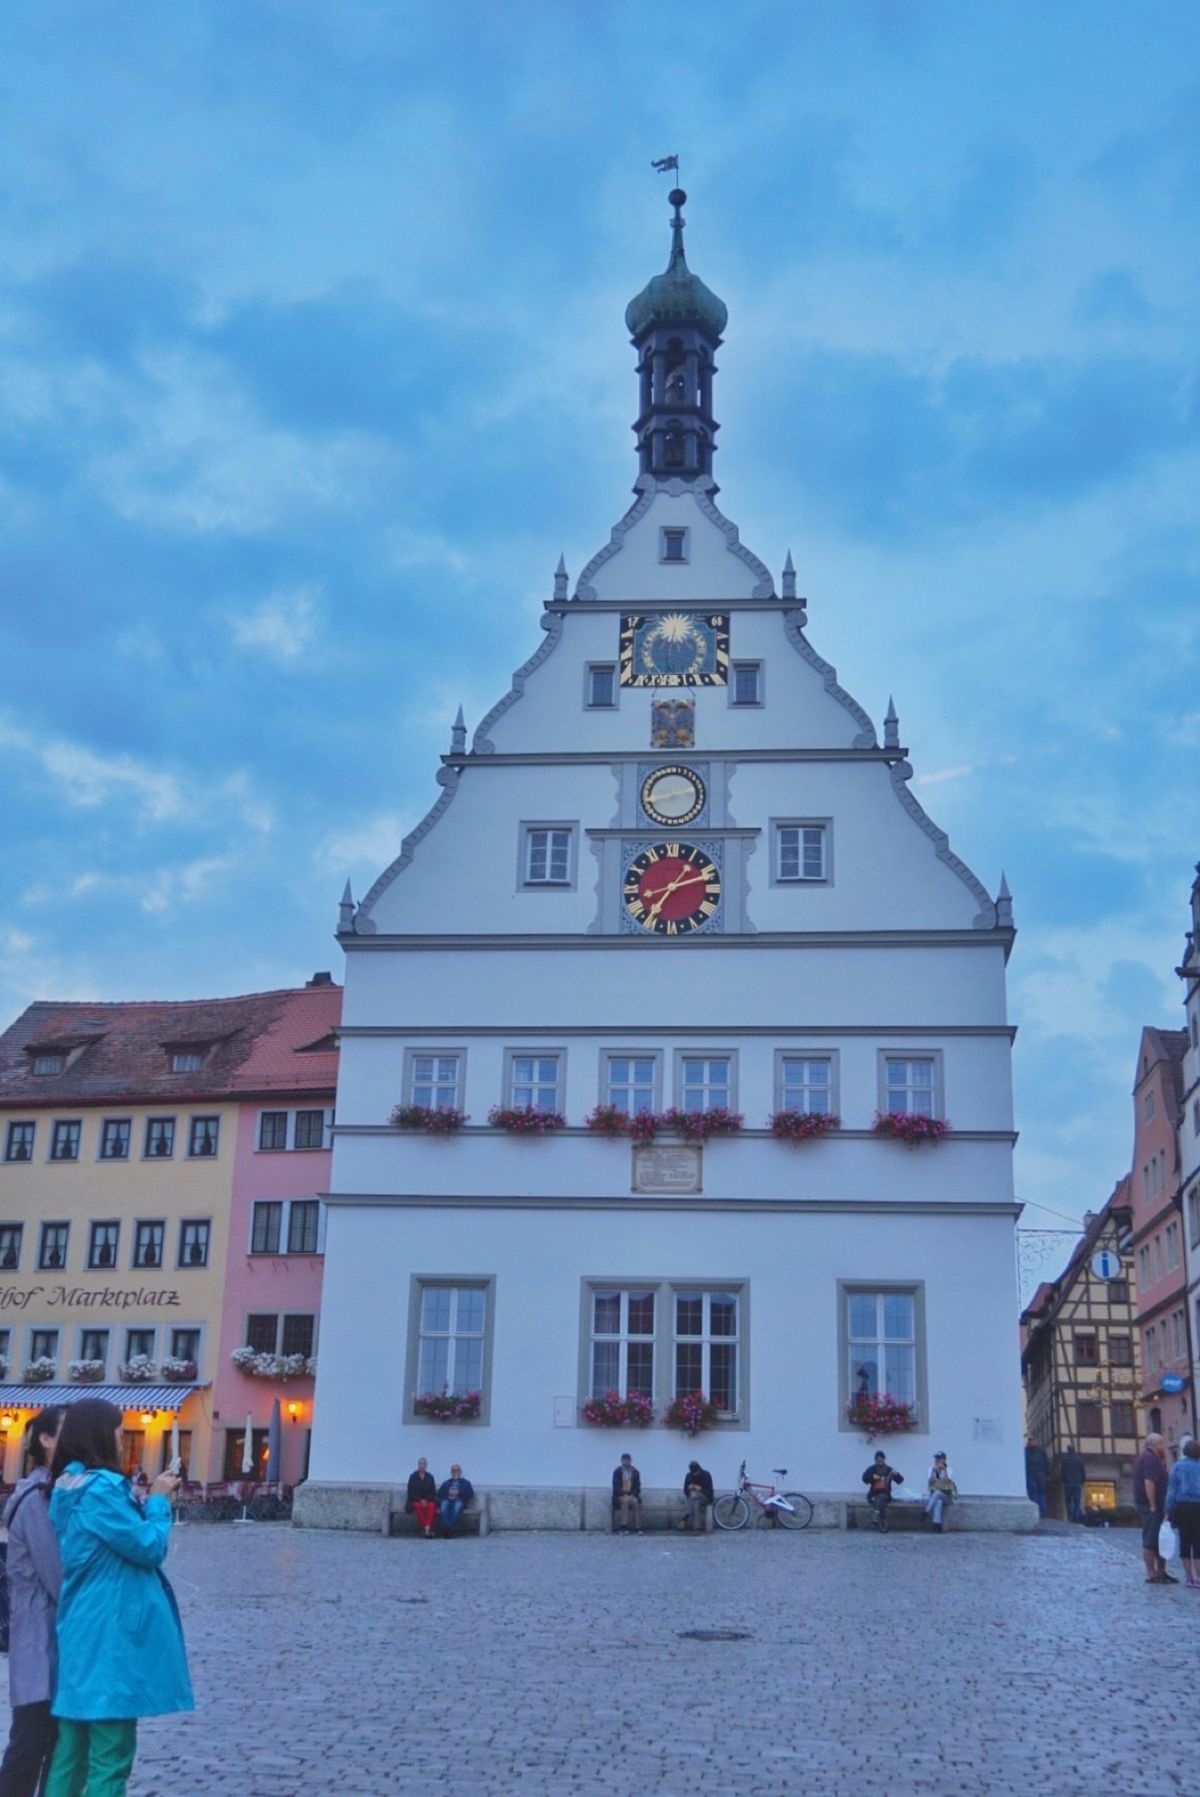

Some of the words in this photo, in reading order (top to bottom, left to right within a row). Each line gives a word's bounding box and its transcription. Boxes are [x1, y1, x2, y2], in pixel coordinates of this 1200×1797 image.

[627, 616, 640, 627] 17
[644, 848, 660, 863] XI
[666, 844, 679, 857] XII
[0, 1286, 44, 1310] hof
[46, 1285, 181, 1310] Marktplatz
